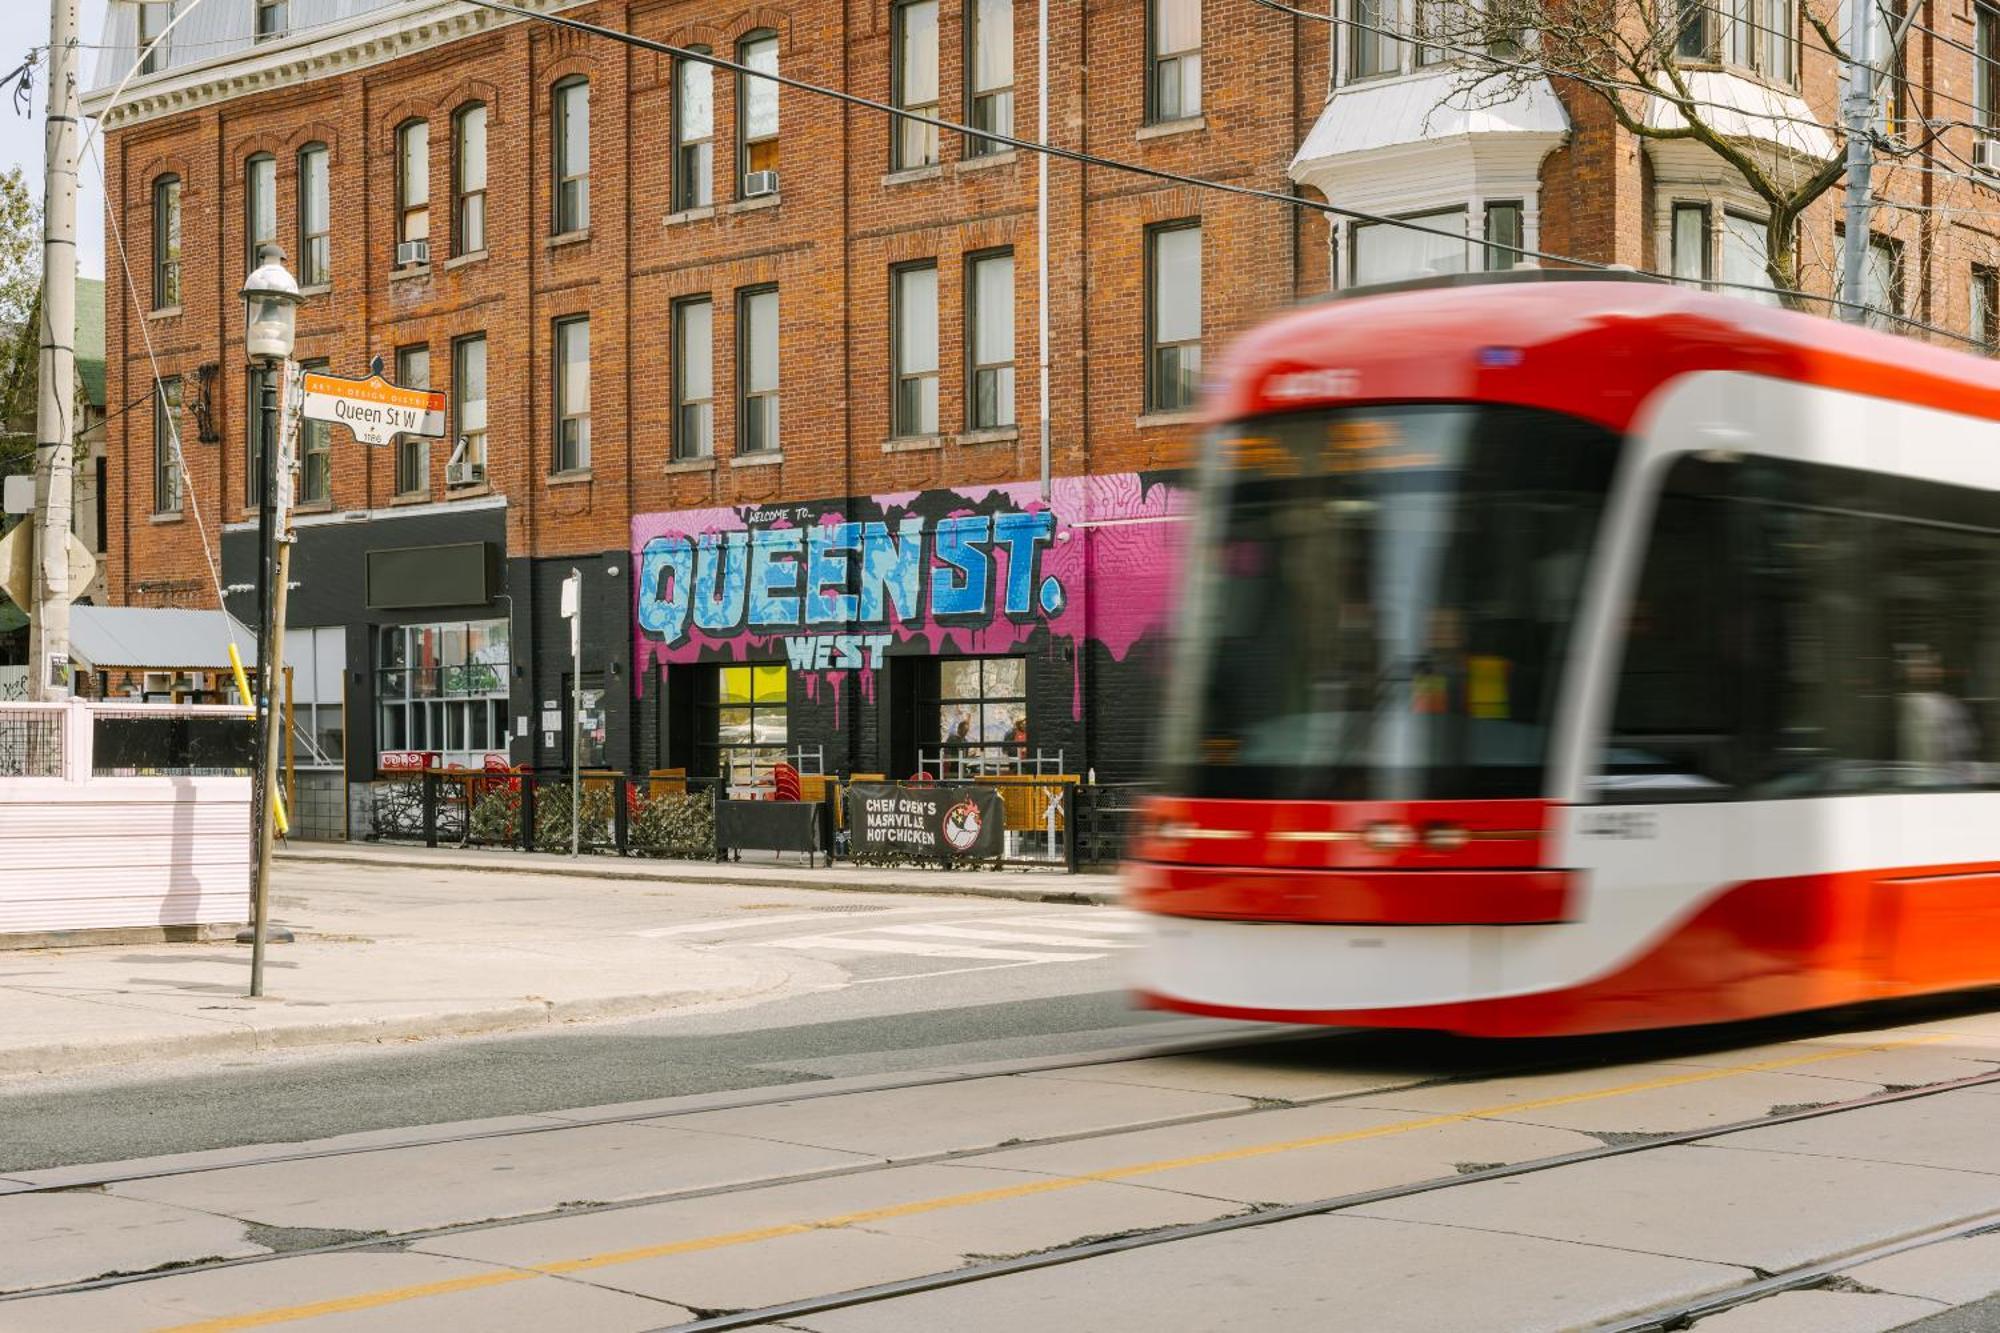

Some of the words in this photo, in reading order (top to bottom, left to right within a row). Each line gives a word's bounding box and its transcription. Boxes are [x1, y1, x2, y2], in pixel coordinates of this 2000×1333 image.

[311, 382, 331, 392] ART
[349, 388, 386, 400] DESIGN
[391, 395, 440, 408] DISTRICT
[335, 399, 382, 423] Queen
[385, 407, 400, 426] St
[403, 411, 417, 429] W
[748, 508, 790, 524] WELCOME
[638, 517, 926, 644] QUEEN
[931, 511, 1064, 616] ST.
[785, 633, 893, 671] WEST
[866, 799, 896, 813] CHEN
[867, 813, 925, 830] NASHVILLE
[867, 828, 887, 842] HOT
[887, 828, 936, 845] CHICKEN
